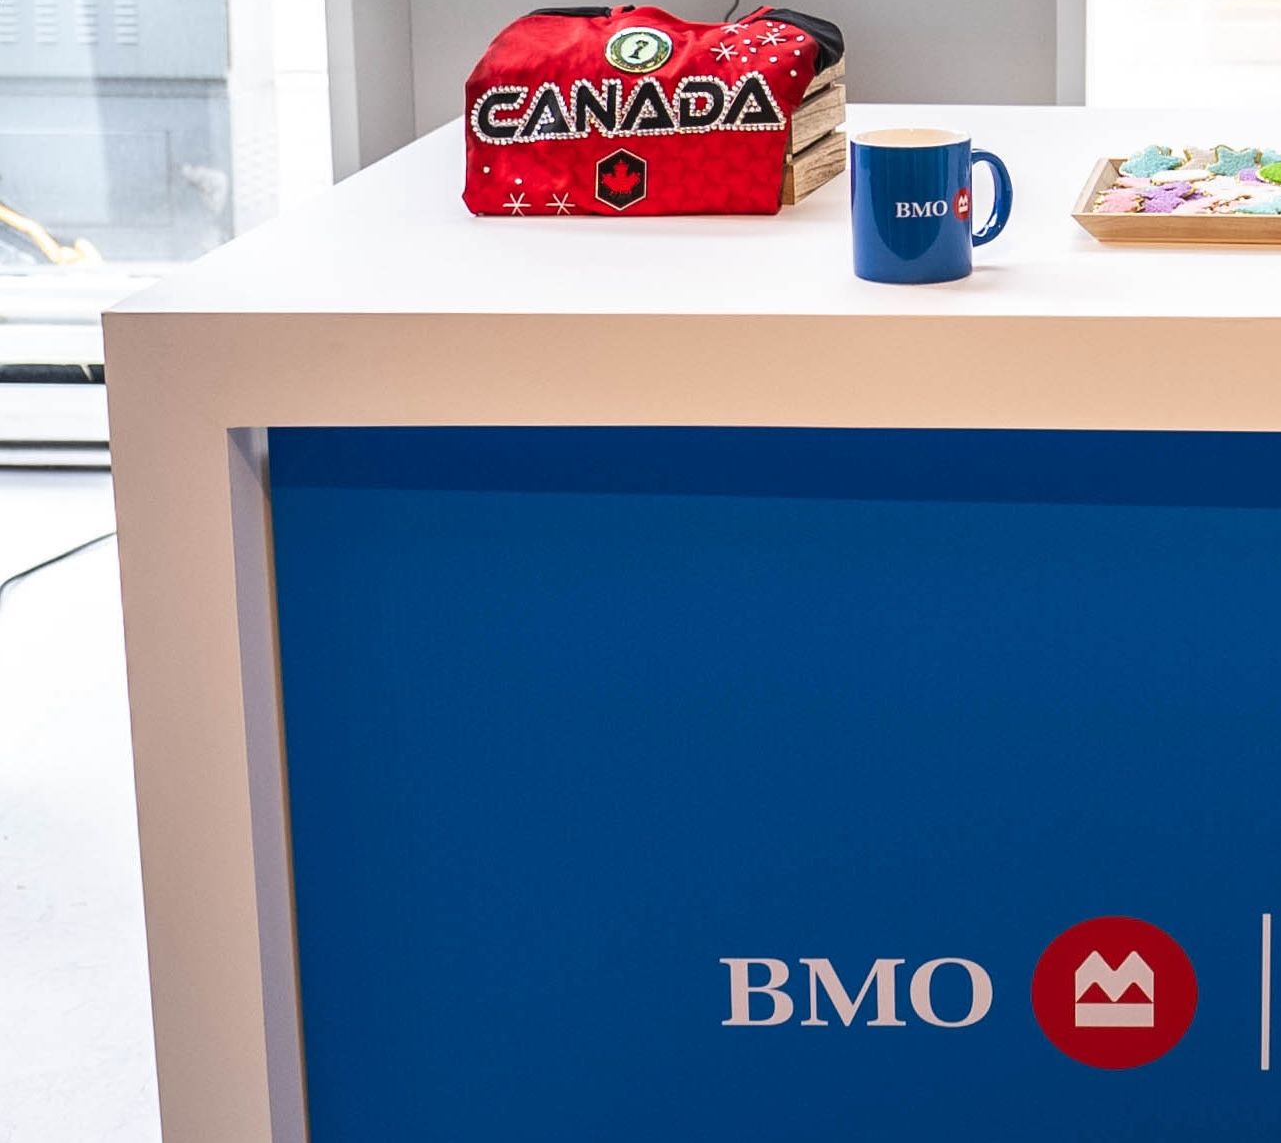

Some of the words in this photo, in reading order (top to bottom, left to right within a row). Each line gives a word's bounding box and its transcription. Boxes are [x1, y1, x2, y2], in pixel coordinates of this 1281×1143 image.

[471, 70, 787, 146] CANADA
[895, 200, 948, 218] BMO
[719, 957, 993, 1028] BMO
